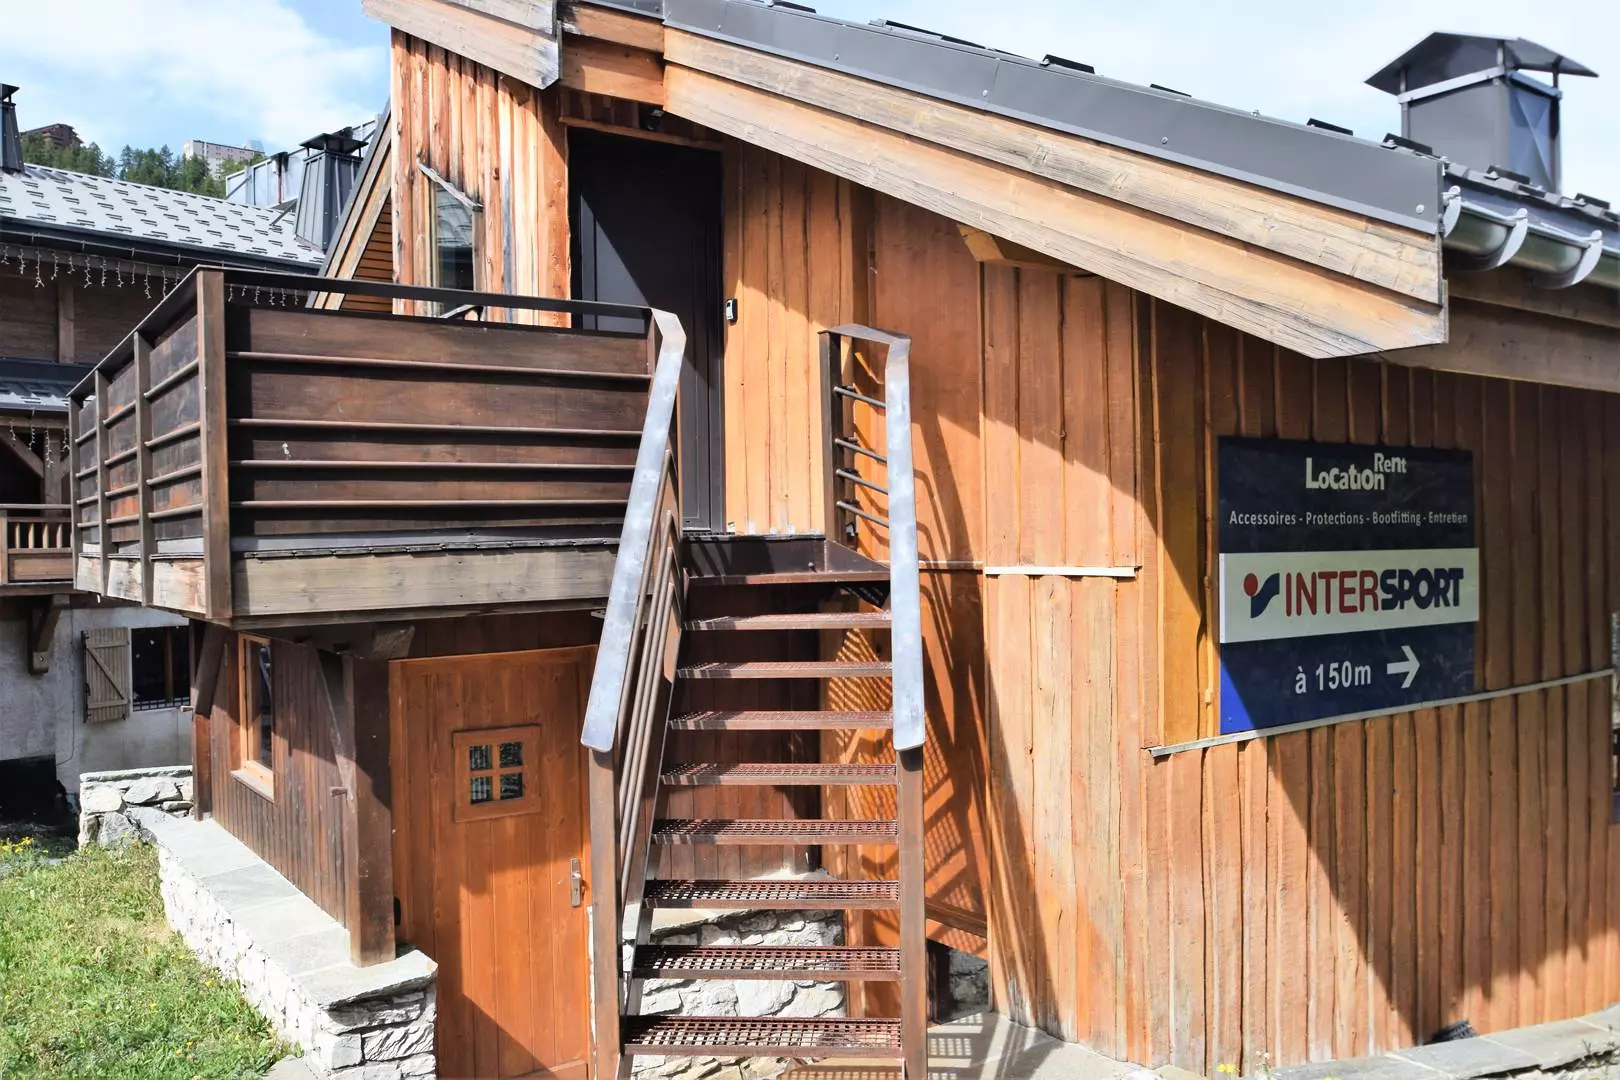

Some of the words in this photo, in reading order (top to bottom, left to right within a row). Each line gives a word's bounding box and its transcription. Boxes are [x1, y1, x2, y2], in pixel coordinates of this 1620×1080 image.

[1305, 457, 1385, 490] Location
[1374, 452, 1407, 473] Rent
[1229, 510, 1297, 525] Accessoires
[1306, 511, 1364, 525] Protections
[1372, 510, 1421, 527] Bootfitting
[1428, 511, 1468, 524] Entretien
[1285, 567, 1464, 617] INTERSPORT
[1295, 666, 1307, 694] à
[1315, 661, 1372, 691] 150m
